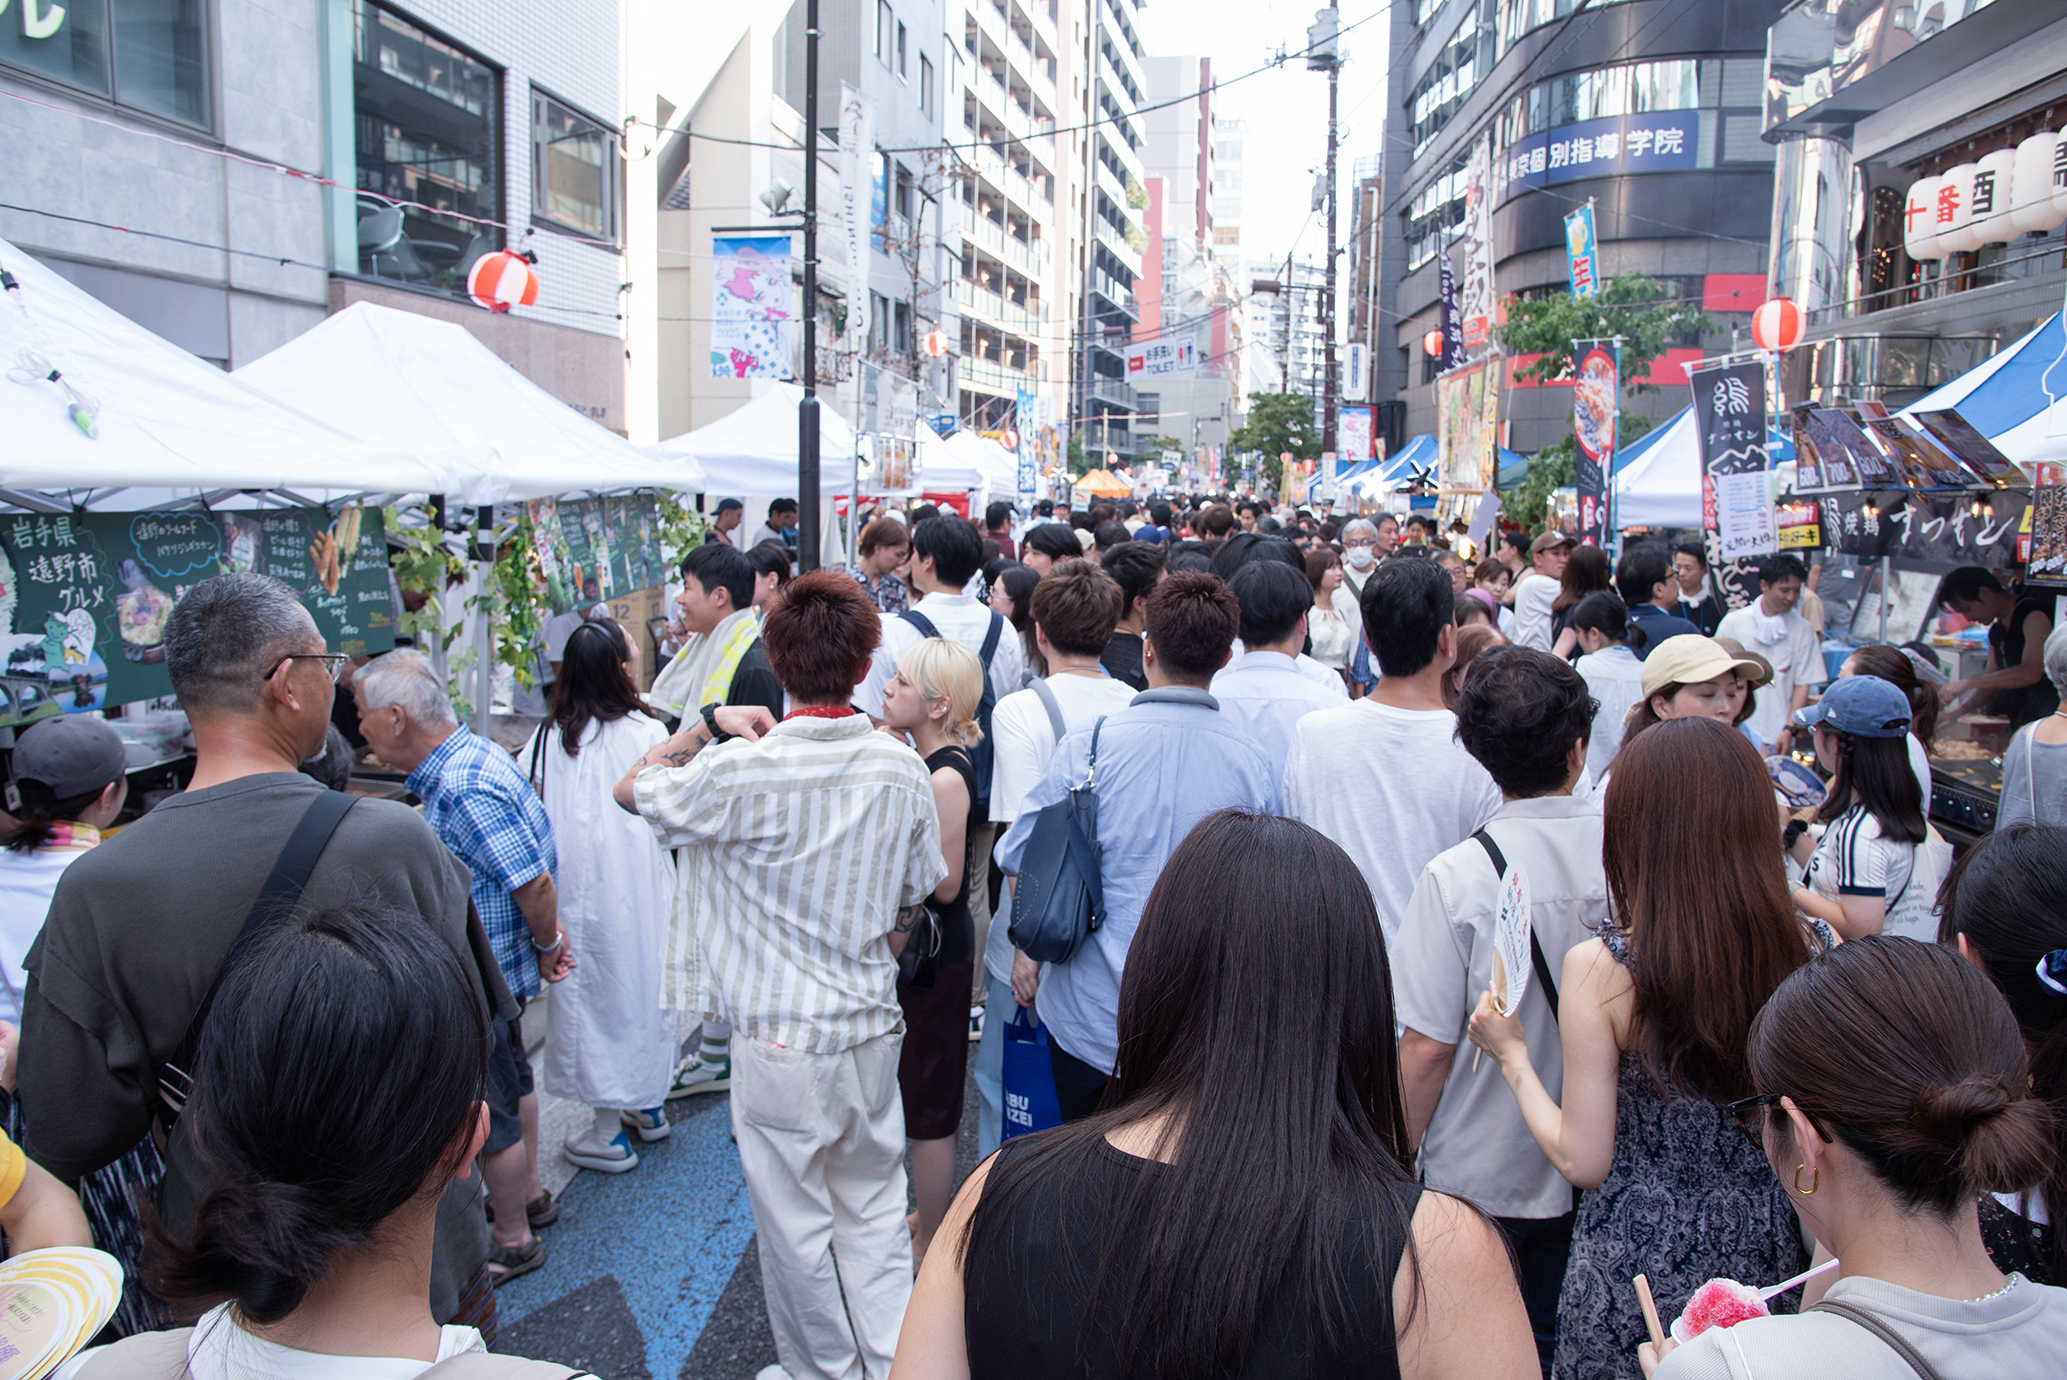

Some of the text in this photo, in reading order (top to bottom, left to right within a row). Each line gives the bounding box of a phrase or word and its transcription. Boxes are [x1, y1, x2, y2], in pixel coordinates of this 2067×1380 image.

[1509, 127, 1684, 180] 東京個別指導学院
[1145, 344, 1174, 360] お手洗い
[1146, 360, 1174, 375] TOILET
[12, 515, 78, 549] 岩手県
[1844, 511, 1880, 537] 焼鶏
[28, 552, 97, 584] 遠野市
[58, 585, 104, 612] グルメ
[612, 603, 631, 621] 12
